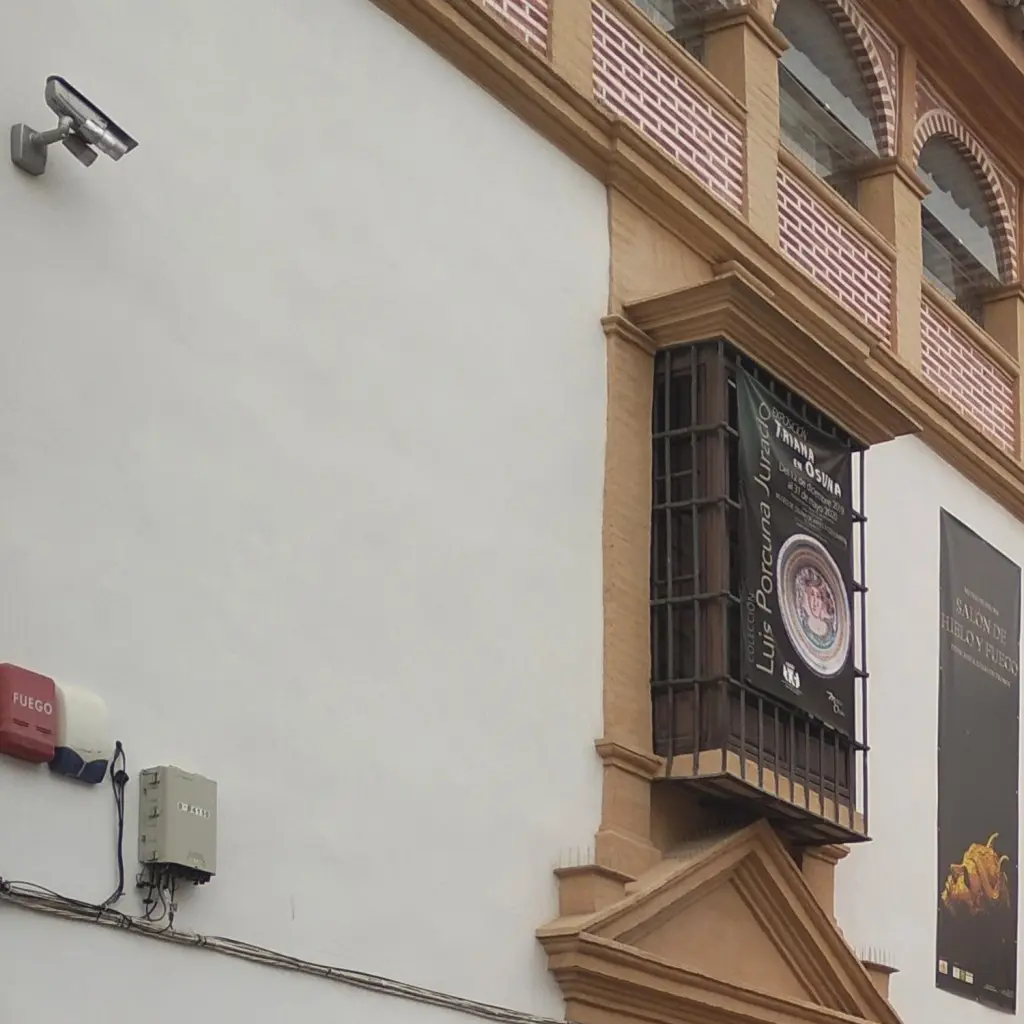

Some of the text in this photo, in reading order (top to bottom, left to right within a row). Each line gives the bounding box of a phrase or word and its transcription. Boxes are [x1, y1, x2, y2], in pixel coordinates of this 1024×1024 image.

[774, 419, 815, 464] TRIANA
[805, 461, 842, 498] OSUNA
[753, 402, 777, 675] Luis Porcuna Jurado
[940, 612, 975, 650] HIELO
[975, 636, 983, 653] Y
[985, 644, 1019, 678] FUEGO
[955, 597, 991, 636] SALÓN
[992, 624, 1008, 647] DE
[13, 692, 53, 715] FUEGO
